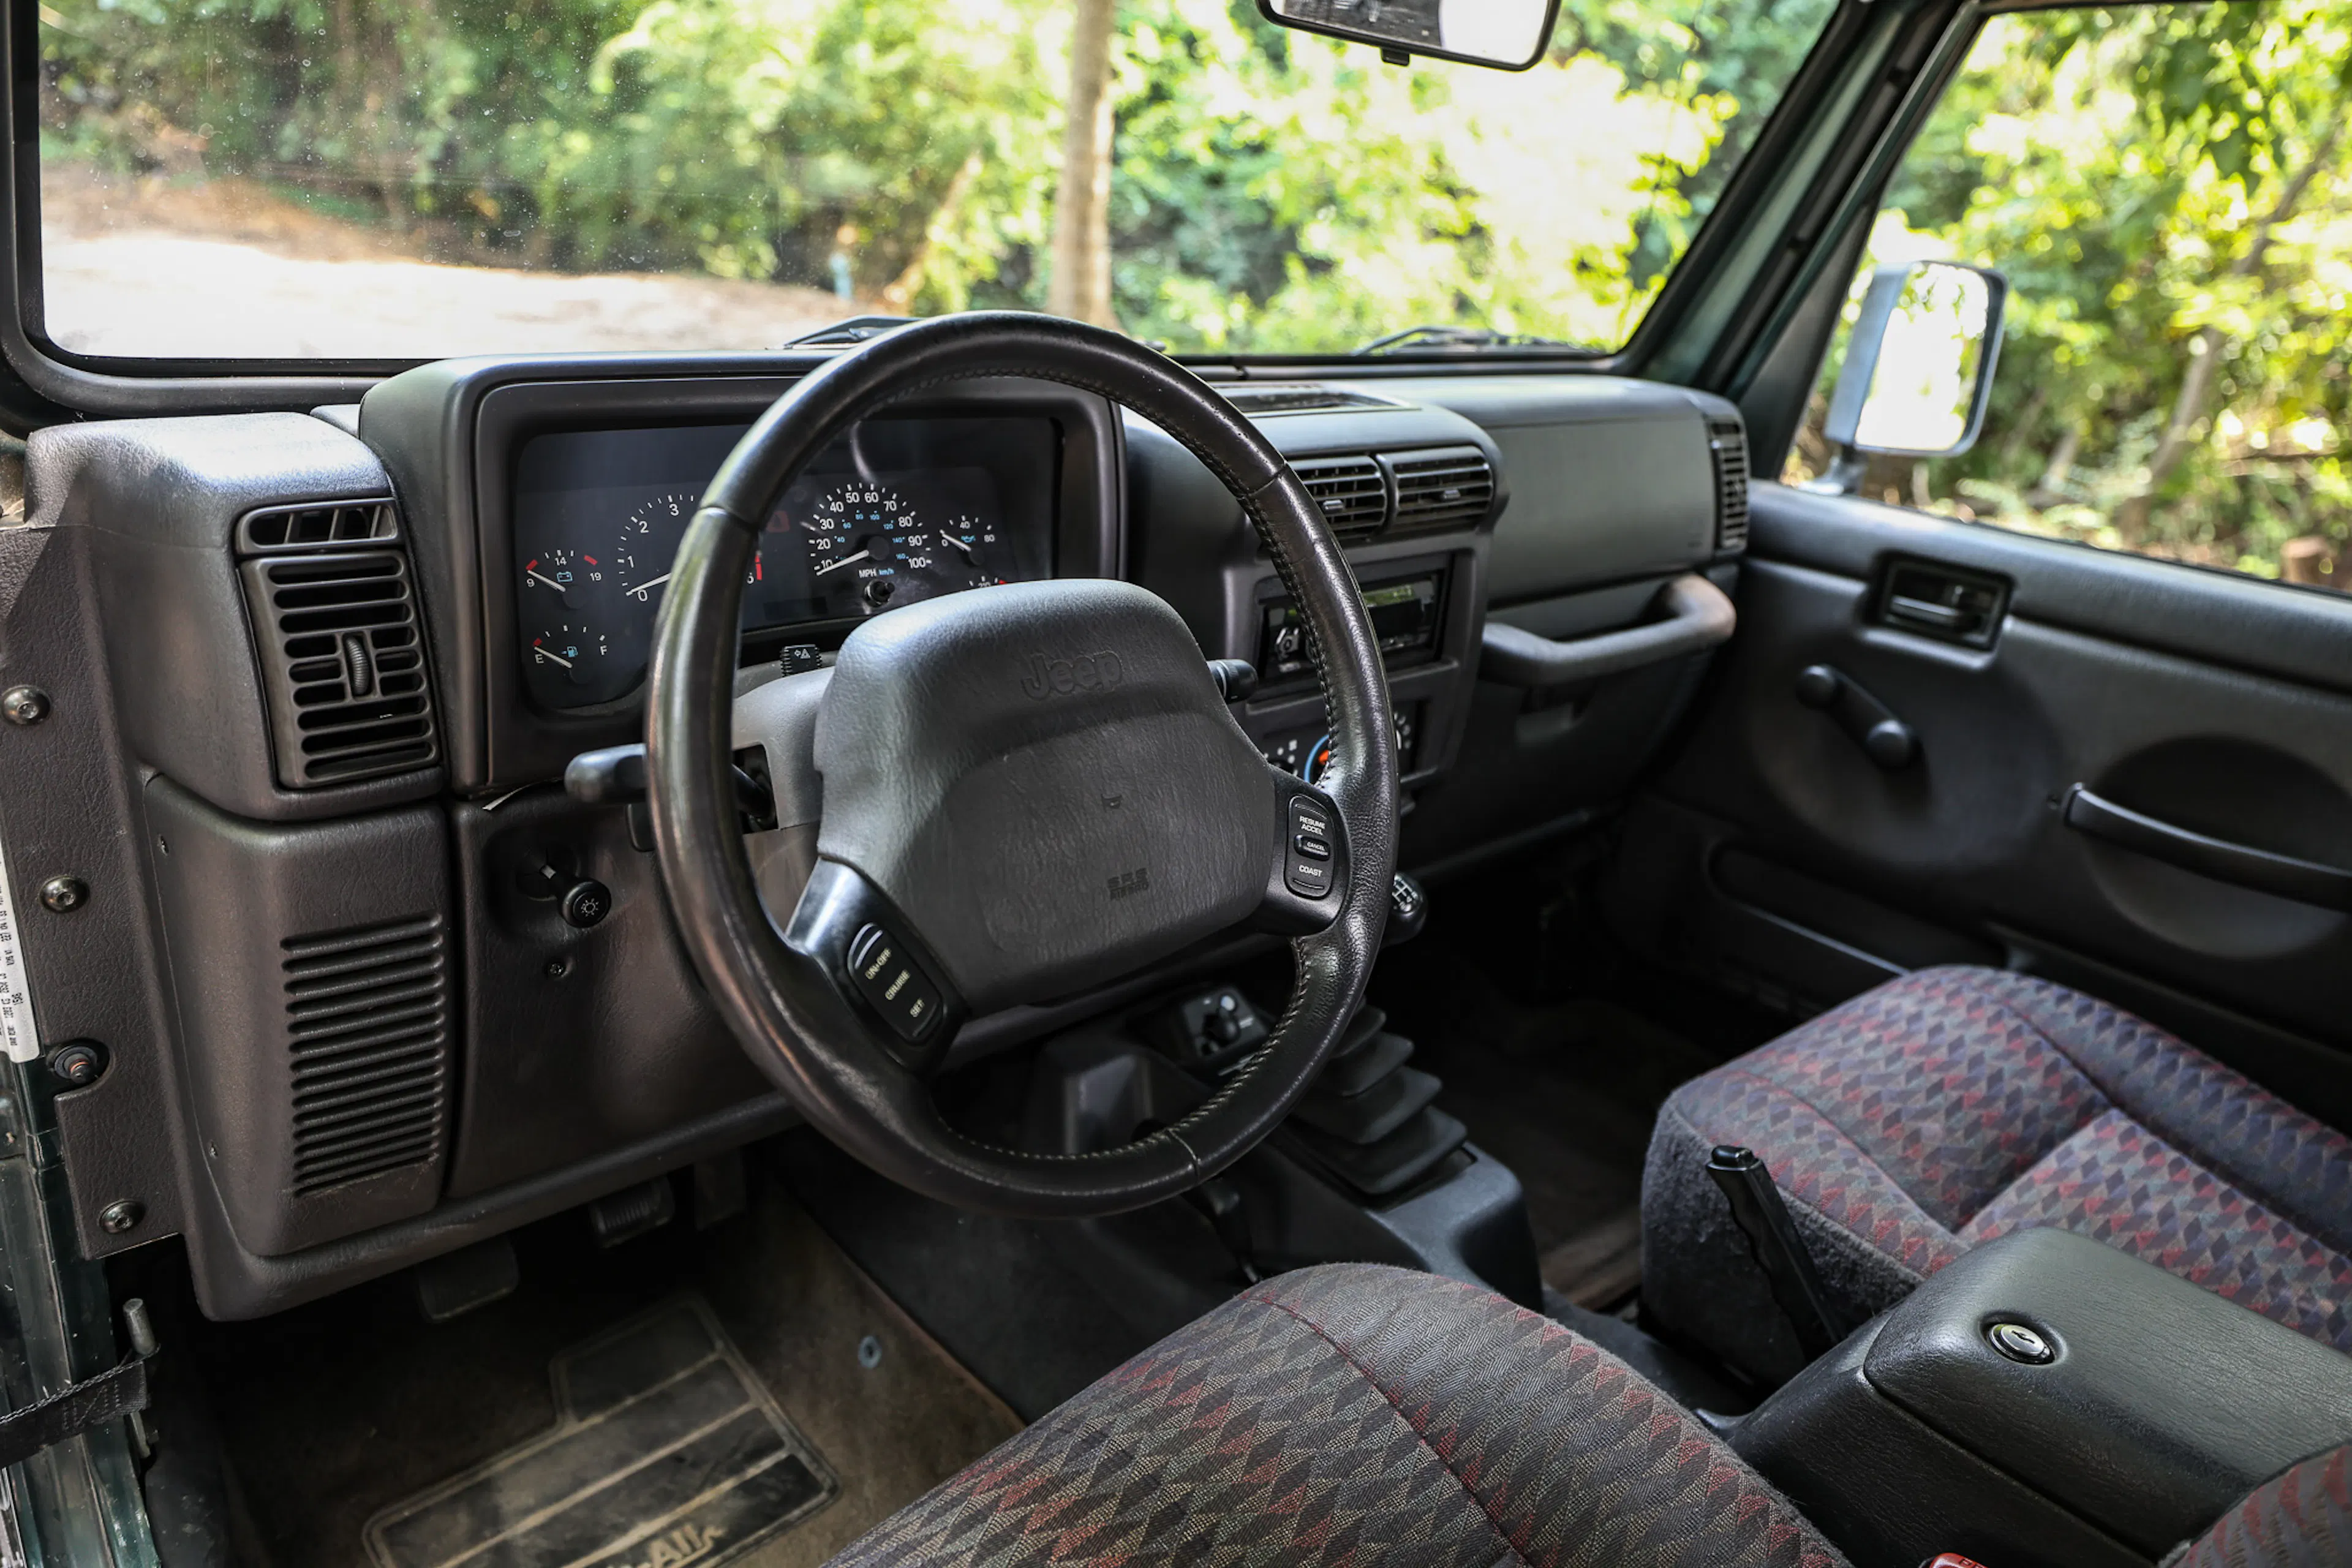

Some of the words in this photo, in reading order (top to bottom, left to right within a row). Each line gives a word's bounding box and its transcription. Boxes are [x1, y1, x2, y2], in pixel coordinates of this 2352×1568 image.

[845, 492, 860, 503] 50
[864, 492, 879, 503] 60
[669, 503, 679, 516] 3
[829, 501, 844, 513] 40
[883, 500, 897, 512] 70
[639, 521, 649, 533] 2
[820, 518, 835, 530] 30
[898, 516, 913, 527] 80
[960, 521, 970, 529] 40
[816, 538, 831, 550] 20
[908, 535, 922, 547] 90
[984, 534, 995, 543] 80
[554, 557, 567, 566] 14
[627, 555, 635, 568] 1
[820, 559, 833, 569] 10
[908, 557, 927, 568] 100
[590, 572, 602, 581] 19
[859, 568, 877, 578] MPH
[526, 578, 535, 587] 9
[638, 589, 648, 601] 0
[600, 645, 607, 655] F
[535, 654, 544, 663] E
[1020, 649, 1125, 700] Jeep
[1300, 816, 1325, 830] RESUME
[1301, 824, 1324, 836] ACCEL
[1306, 841, 1325, 851] CANCEL
[1298, 864, 1323, 877] COAST
[884, 969, 911, 1000] CRUISE
[910, 998, 925, 1017] SET
